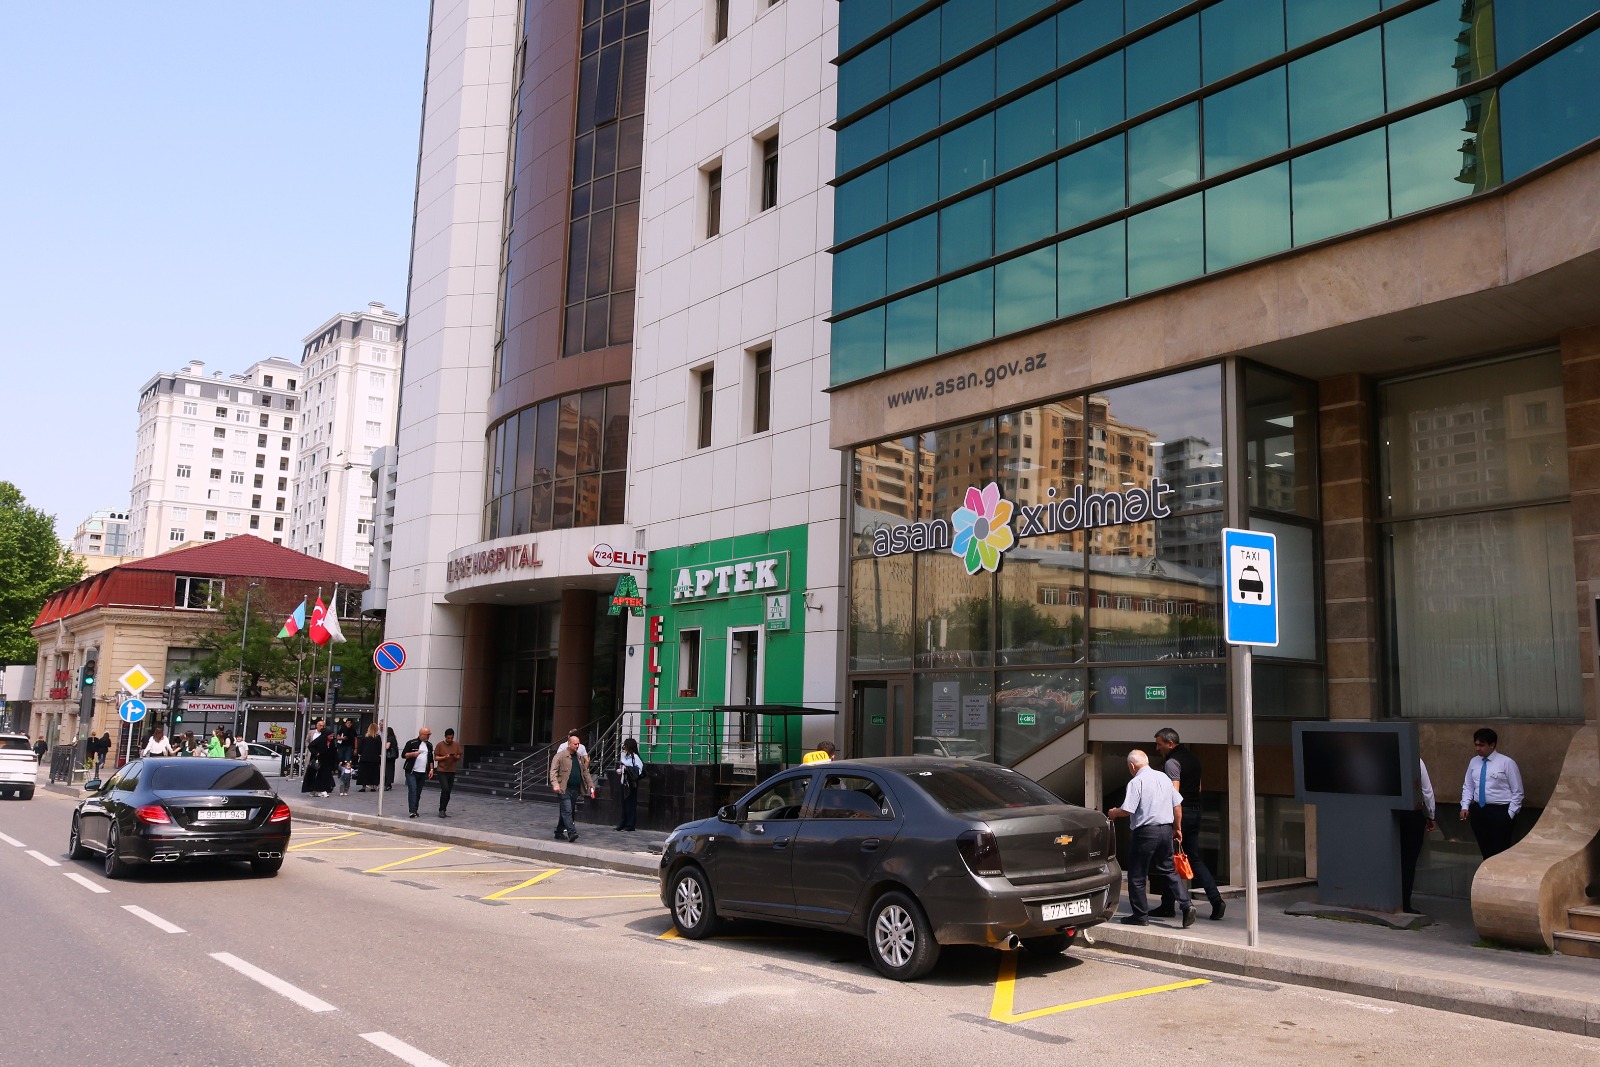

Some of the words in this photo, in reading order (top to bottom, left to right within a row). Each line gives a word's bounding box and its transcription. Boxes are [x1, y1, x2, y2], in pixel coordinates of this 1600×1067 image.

[887, 352, 1047, 409] www.asan.gov.az
[872, 519, 949, 557] asan
[1020, 477, 1172, 537] xidmət
[473, 543, 543, 577] HOSPITAL
[595, 550, 612, 560] 7/24
[1240, 550, 1260, 561] TAXI
[673, 559, 779, 599] APTEK
[612, 597, 643, 607] APTEK
